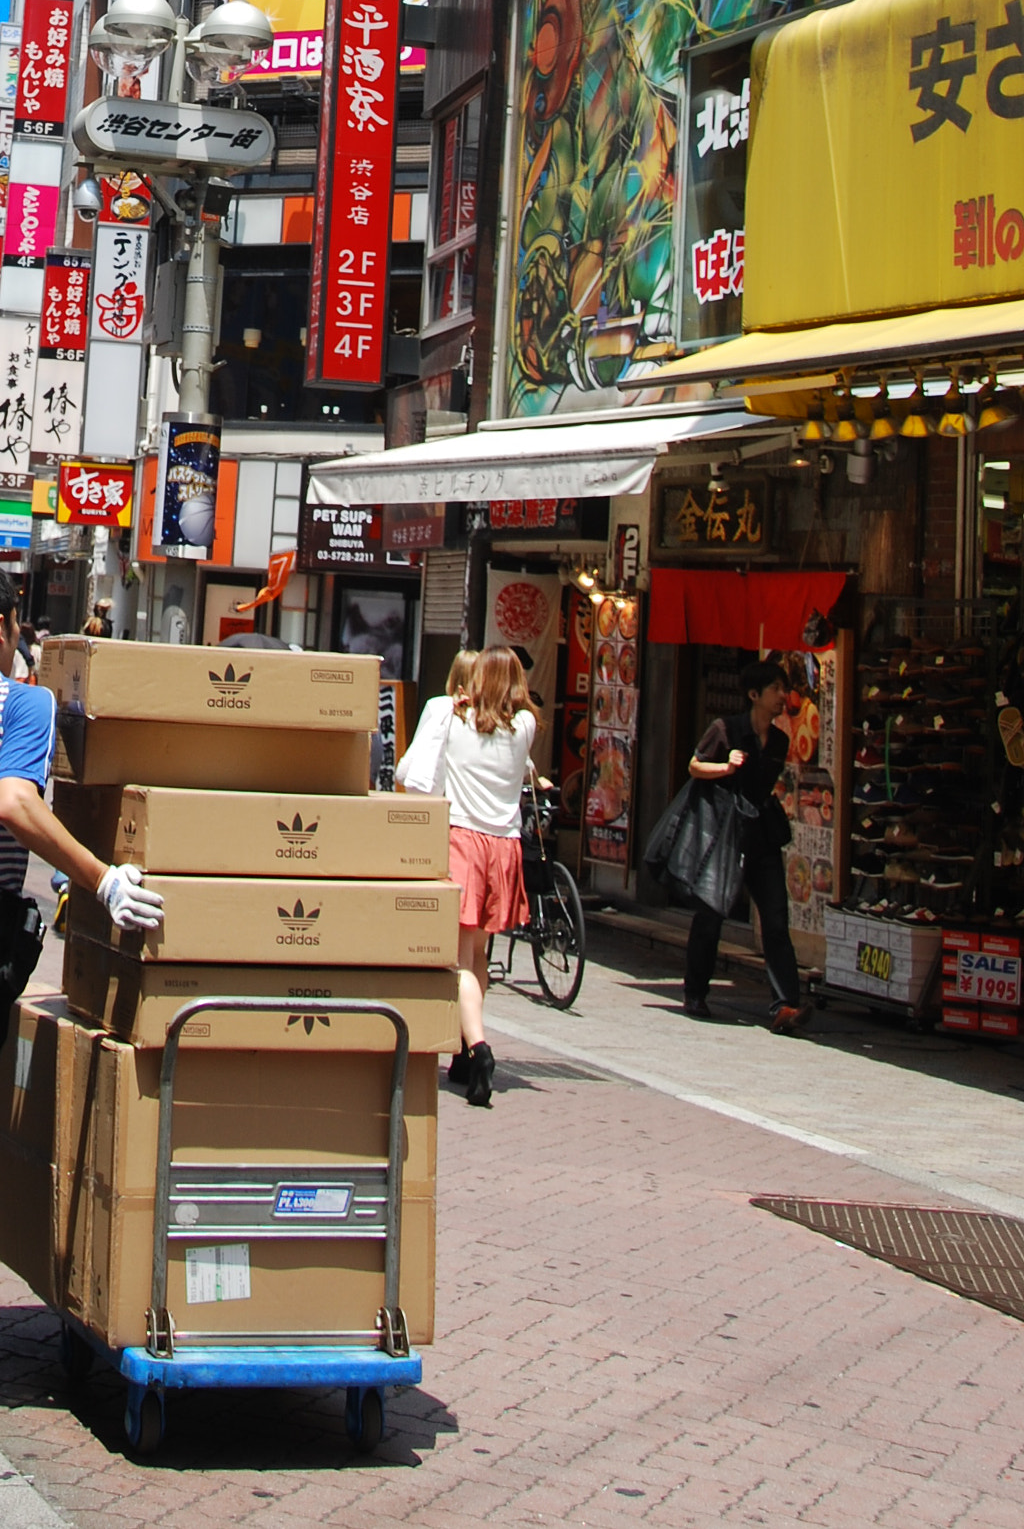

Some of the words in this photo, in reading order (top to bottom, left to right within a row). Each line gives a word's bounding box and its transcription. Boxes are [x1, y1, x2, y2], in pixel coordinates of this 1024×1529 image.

[43, 7, 69, 88] お好み焼
[22, 41, 43, 114] もんじゃ
[96, 113, 264, 150] 渋谷センター街
[346, 158, 375, 227] 渋谷店
[17, 255, 36, 267] 4F
[338, 248, 376, 275] 2F
[46, 286, 63, 345] もんじゃ
[64, 270, 83, 335] お好み焼
[336, 290, 375, 317] 3F
[334, 334, 373, 360] 4F
[7, 351, 20, 390] お食事
[42, 383, 77, 445] 椿や
[68, 467, 125, 510] すき家
[313, 508, 337, 522] PET
[677, 488, 762, 543] 金伝丸
[329, 538, 365, 549] SHIBUYA
[332, 523, 363, 537] WAN
[313, 672, 351, 682] ORIGINALS
[207, 695, 252, 710] adidas
[390, 813, 427, 823] ORIGINALS
[275, 846, 318, 860] adidas
[398, 900, 436, 910] ORIGINALS
[276, 932, 320, 946] adidas
[961, 954, 1017, 975] SALE
[960, 974, 1017, 1002] ¥1995
